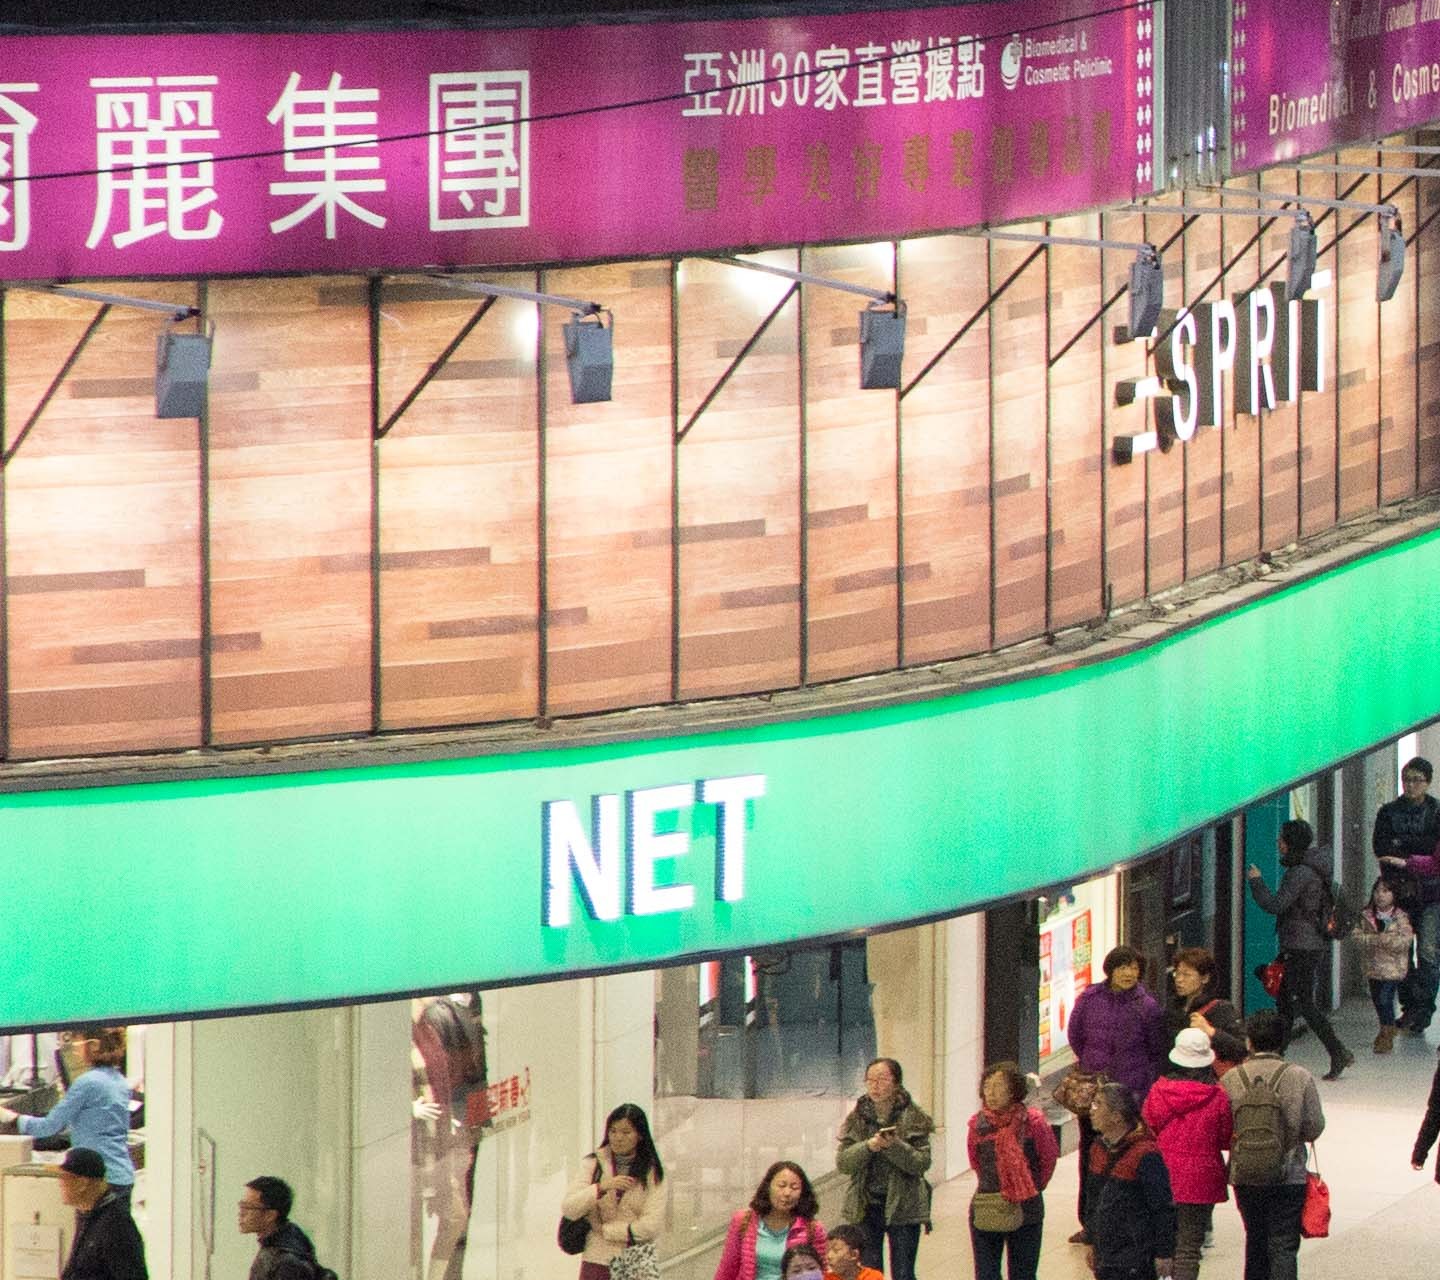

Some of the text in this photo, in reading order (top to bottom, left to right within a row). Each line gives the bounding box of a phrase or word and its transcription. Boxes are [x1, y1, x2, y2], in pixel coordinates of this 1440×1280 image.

[681, 34, 987, 117] 亞洲30家直營據點
[1118, 268, 1332, 454] ESPRIT
[541, 774, 767, 928] NET
